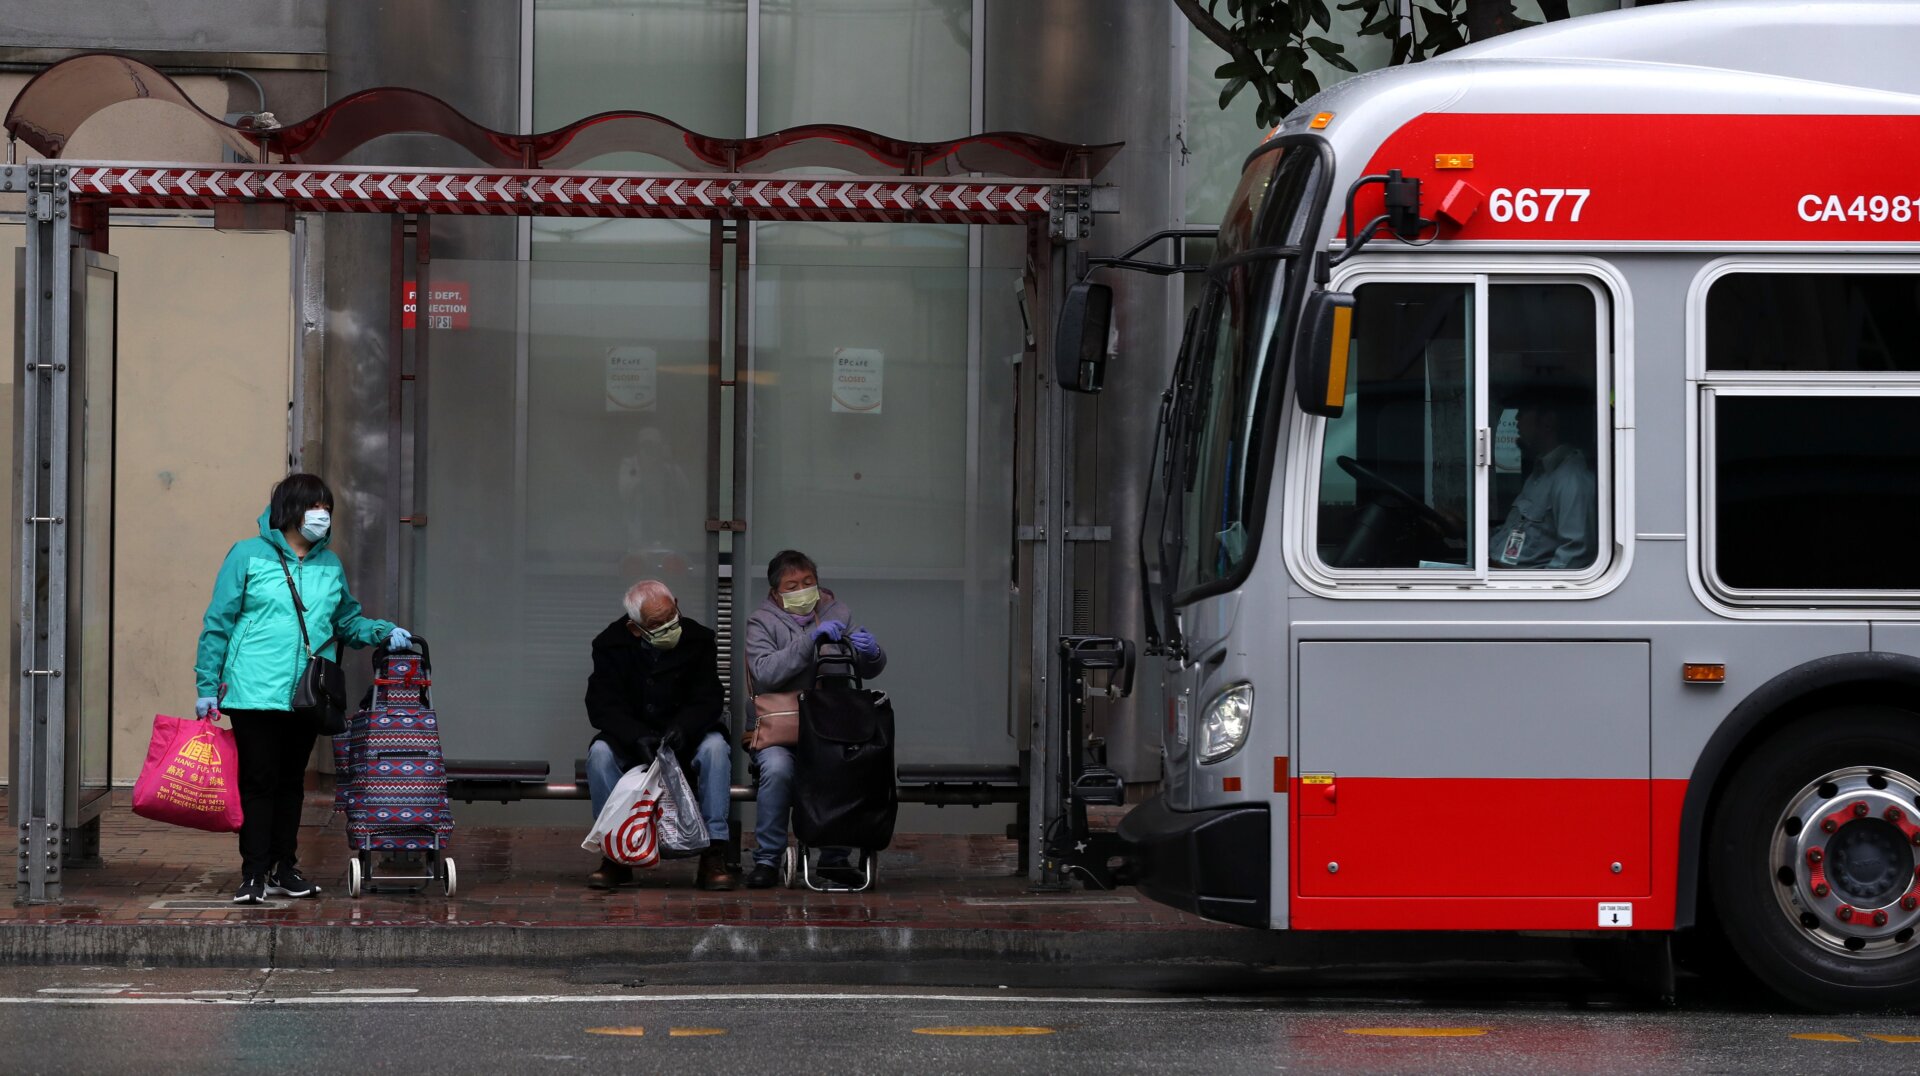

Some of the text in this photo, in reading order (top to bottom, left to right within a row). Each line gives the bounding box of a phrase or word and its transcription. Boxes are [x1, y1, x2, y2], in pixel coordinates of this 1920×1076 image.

[1489, 188, 1591, 223] 6677
[435, 291, 462, 300] DEPT.
[436, 316, 451, 329] PSI
[838, 375, 866, 383] CLOSED
[174, 757, 195, 768] HANG
